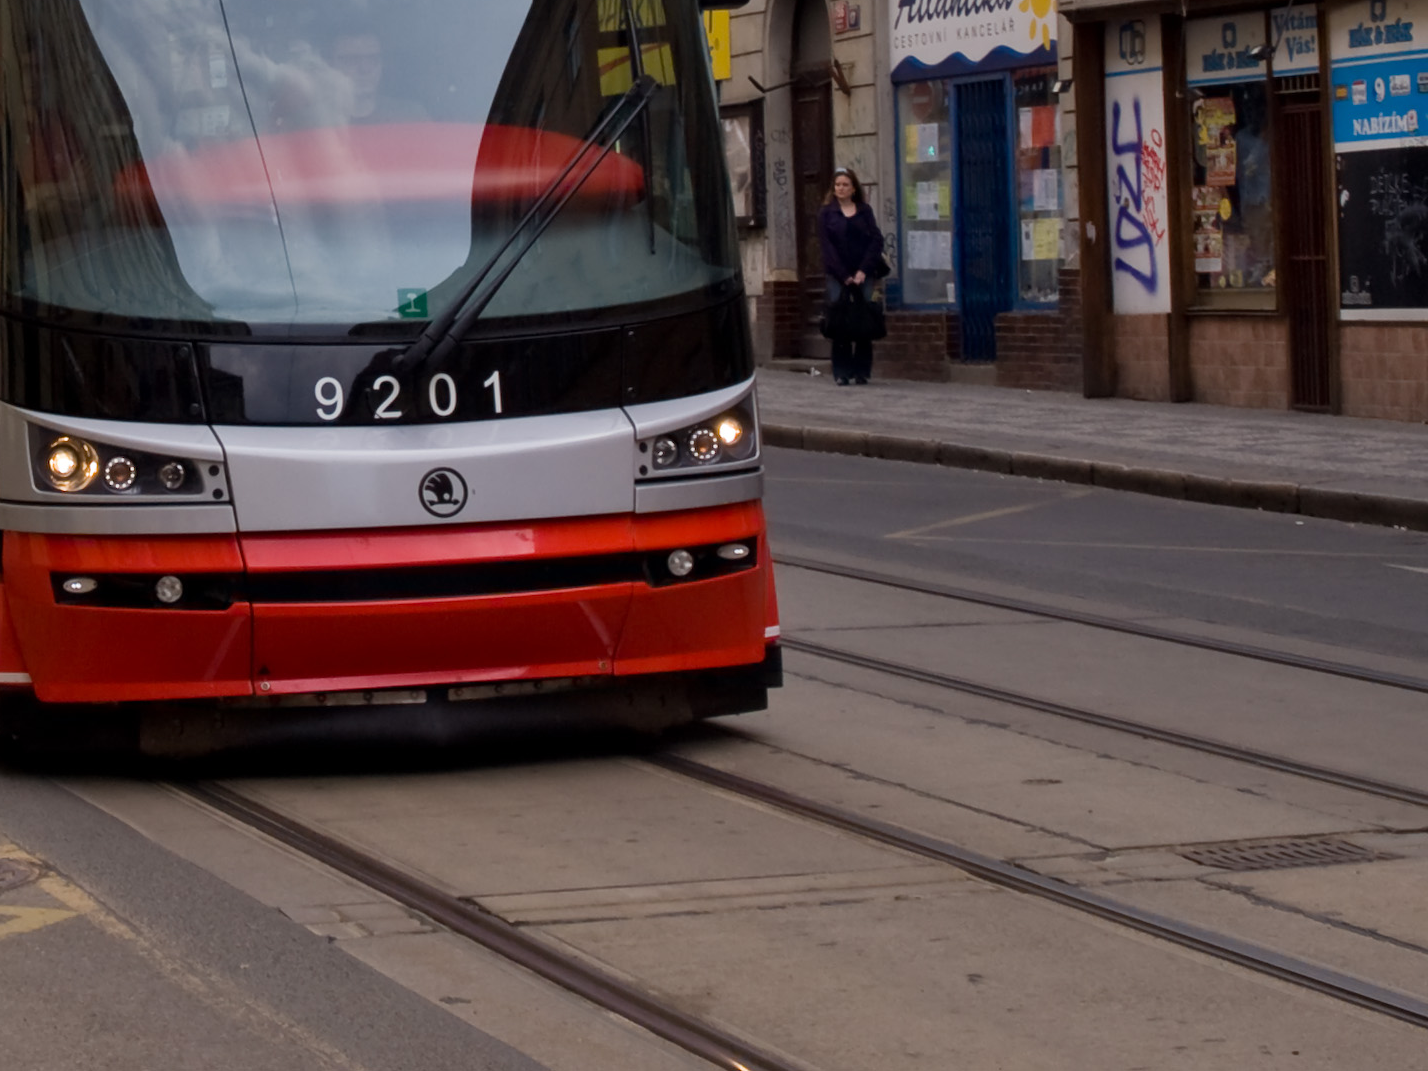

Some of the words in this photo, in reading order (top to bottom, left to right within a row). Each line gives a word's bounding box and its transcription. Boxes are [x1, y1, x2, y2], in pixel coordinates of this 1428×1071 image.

[894, 27, 947, 49] CESTOVNÍ
[957, 17, 1015, 40] KANCELÁŘ
[1353, 111, 1412, 136] NABÍZÍM
[314, 370, 503, 420] 9201
